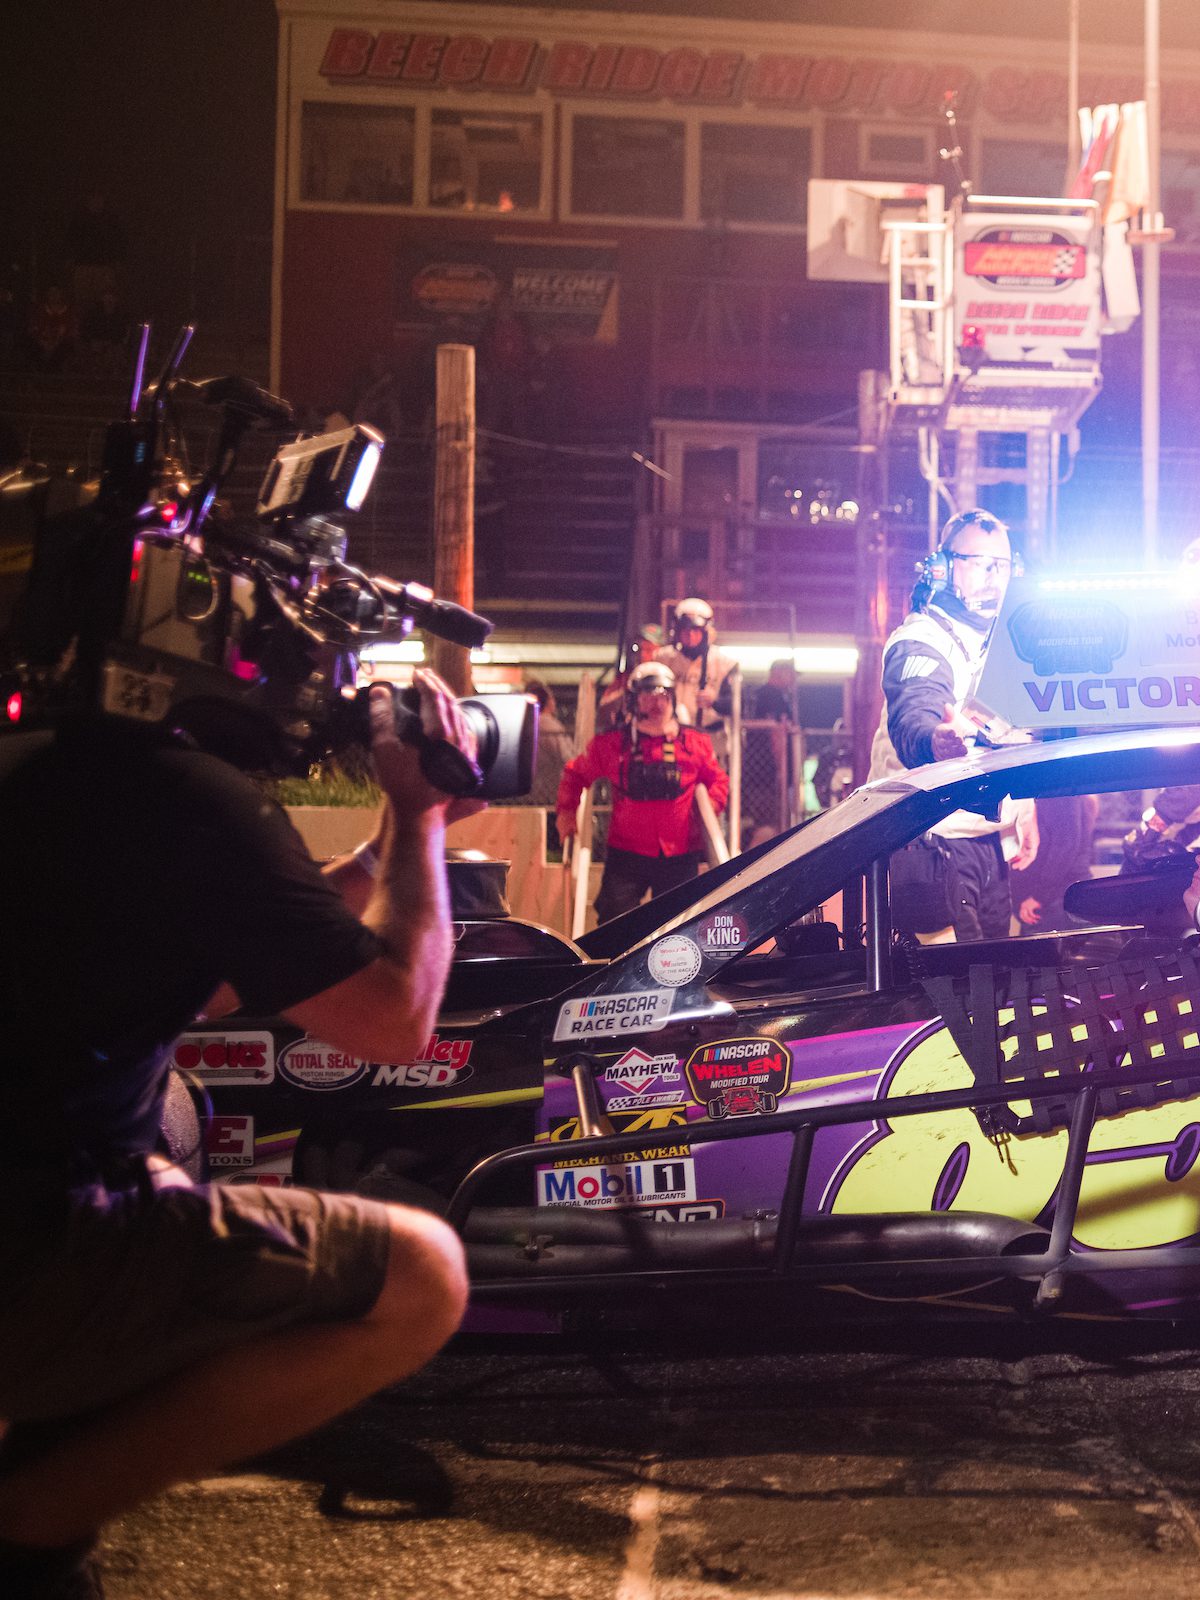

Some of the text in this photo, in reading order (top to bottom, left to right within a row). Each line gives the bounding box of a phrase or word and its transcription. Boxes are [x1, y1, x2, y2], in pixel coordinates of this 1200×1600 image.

[320, 27, 542, 93] BEECH
[541, 40, 746, 101] RIDGE
[1037, 635, 1104, 647] MODIFIED TOUR
[714, 915, 734, 928] DON
[706, 927, 742, 946] KING
[593, 995, 660, 1018] NASCAR
[570, 1014, 653, 1034] RACE CAR
[174, 1040, 268, 1069] OOKS
[288, 1053, 359, 1069] TOTAL SEAL
[719, 1042, 771, 1061] NASCAR
[371, 1064, 458, 1088] MSD
[606, 1061, 675, 1081] MAYHEW
[691, 1053, 783, 1081] WHELEN
[710, 1075, 769, 1089] MODIFIED TOUR
[210, 1155, 252, 1165] TONS
[544, 1165, 643, 1202] Mobil
[583, 1198, 612, 1207] MOTOR
[636, 1192, 686, 1201] LUBRICANTS
